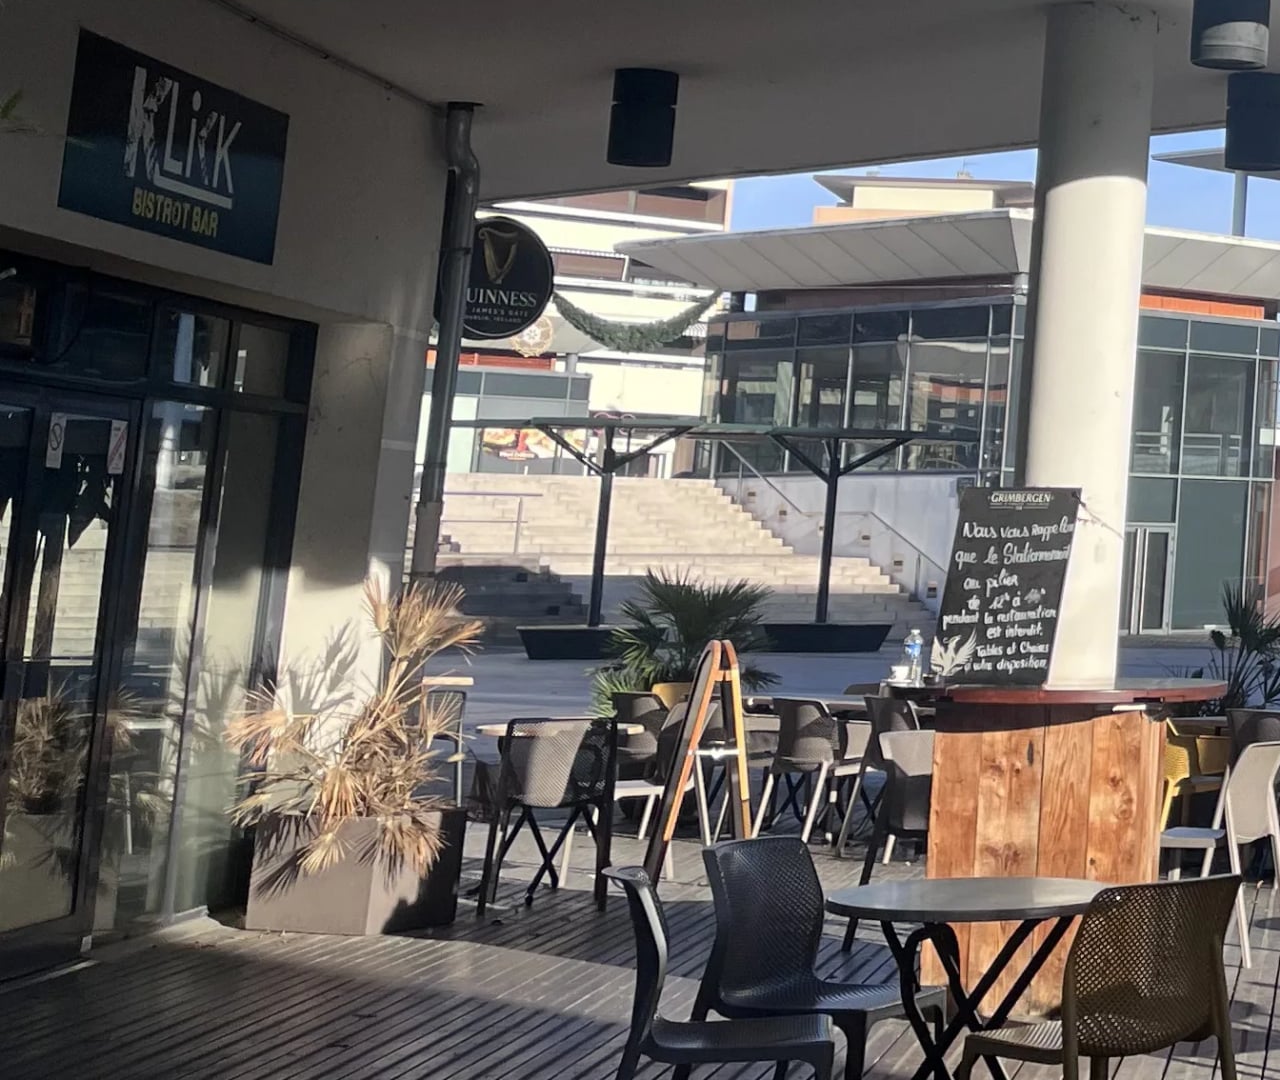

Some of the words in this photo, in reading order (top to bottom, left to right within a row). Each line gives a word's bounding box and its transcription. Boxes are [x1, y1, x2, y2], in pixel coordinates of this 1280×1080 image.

[132, 186, 194, 230] BISTROT
[191, 206, 219, 238] BAR
[466, 287, 538, 308] UINNESS
[990, 491, 1051, 503] GRIMBERGEN
[962, 521, 998, 538] Nous
[1000, 525, 1030, 539] vous
[955, 550, 978, 571] que
[983, 545, 999, 565] le
[963, 577, 981, 590] au
[985, 567, 1019, 598] pilier
[966, 594, 981, 610] de
[942, 609, 979, 631] pendant
[984, 611, 994, 624] la
[997, 604, 1057, 623] restauration
[986, 625, 1002, 639] est
[975, 643, 1003, 658] Tables
[1006, 641, 1017, 655] et
